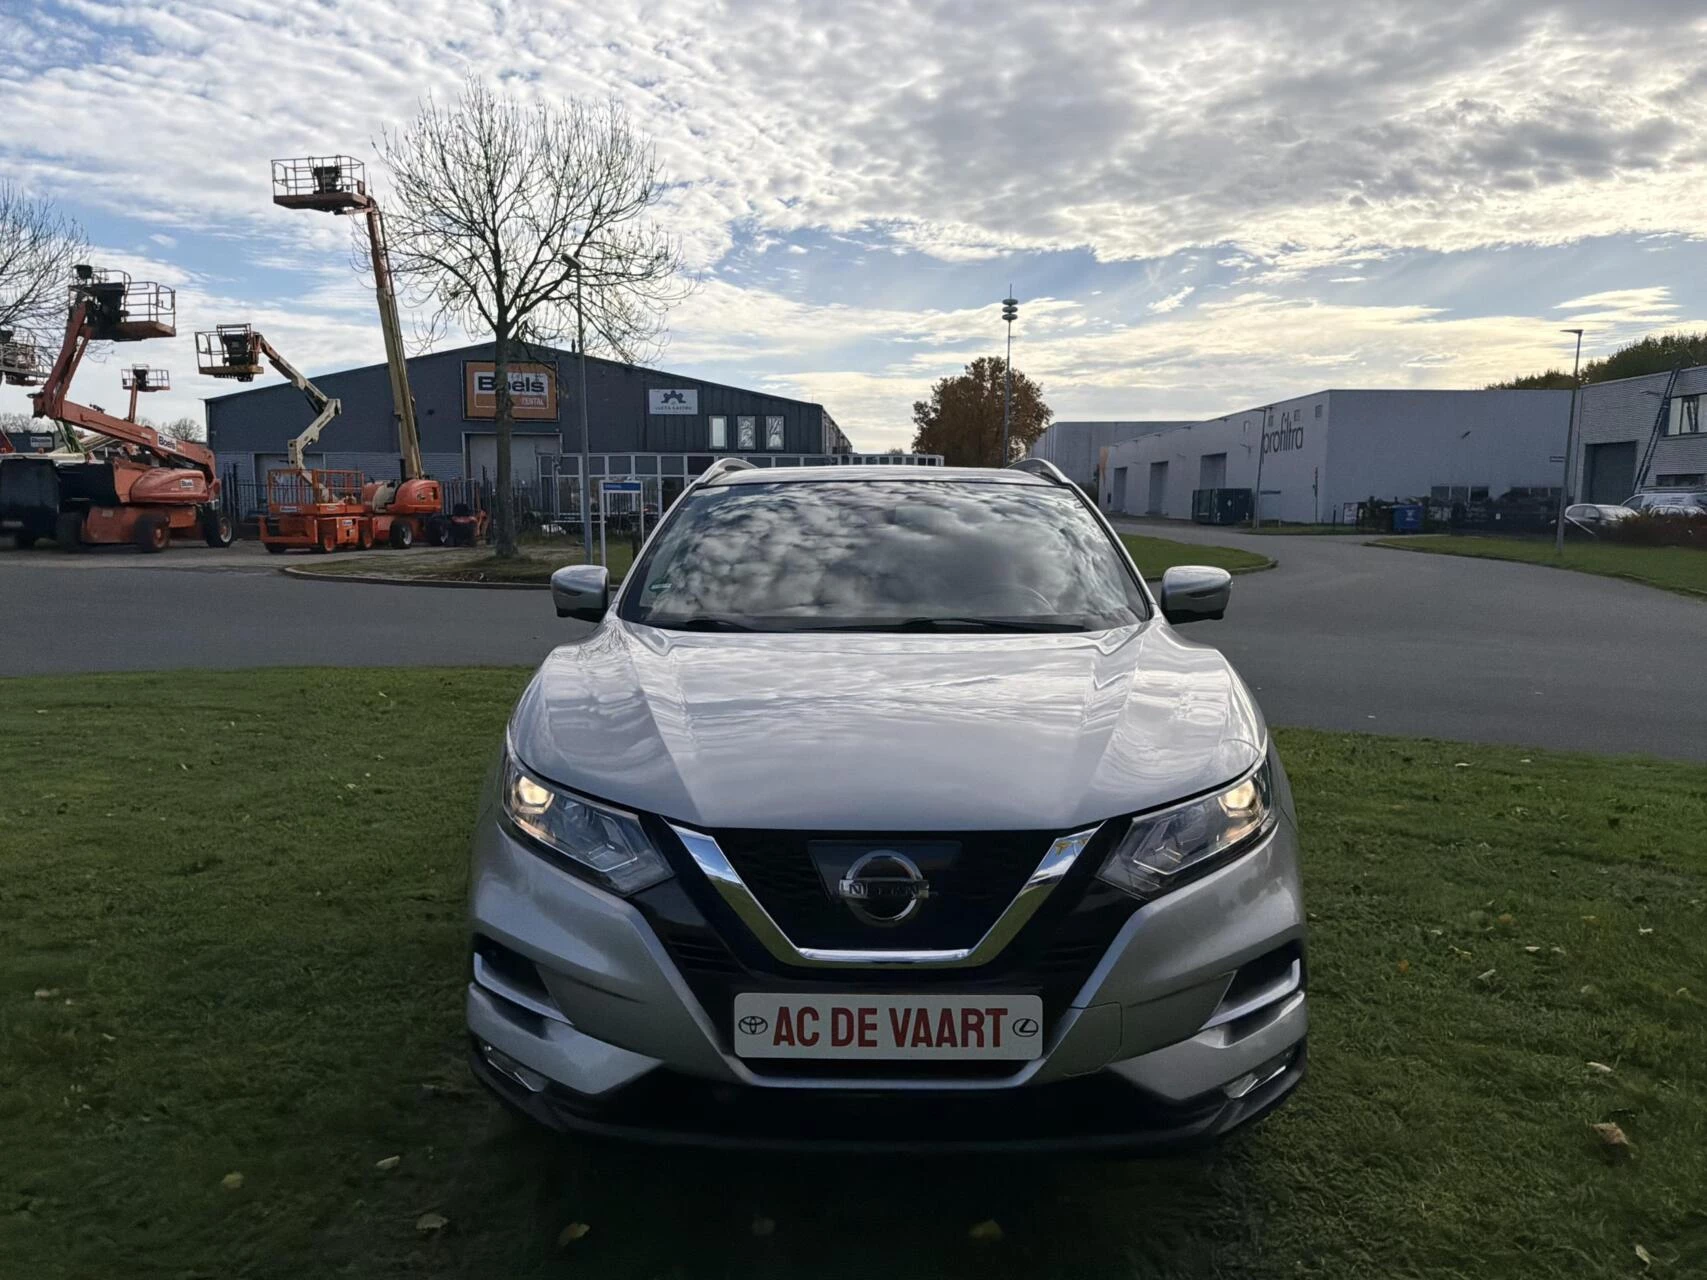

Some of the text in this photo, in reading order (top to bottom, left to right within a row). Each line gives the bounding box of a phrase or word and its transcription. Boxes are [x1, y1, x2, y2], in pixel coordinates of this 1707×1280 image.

[478, 375, 544, 393] Bels
[1262, 412, 1304, 465] profiltra
[773, 1006, 1008, 1048] AC DE VAART
